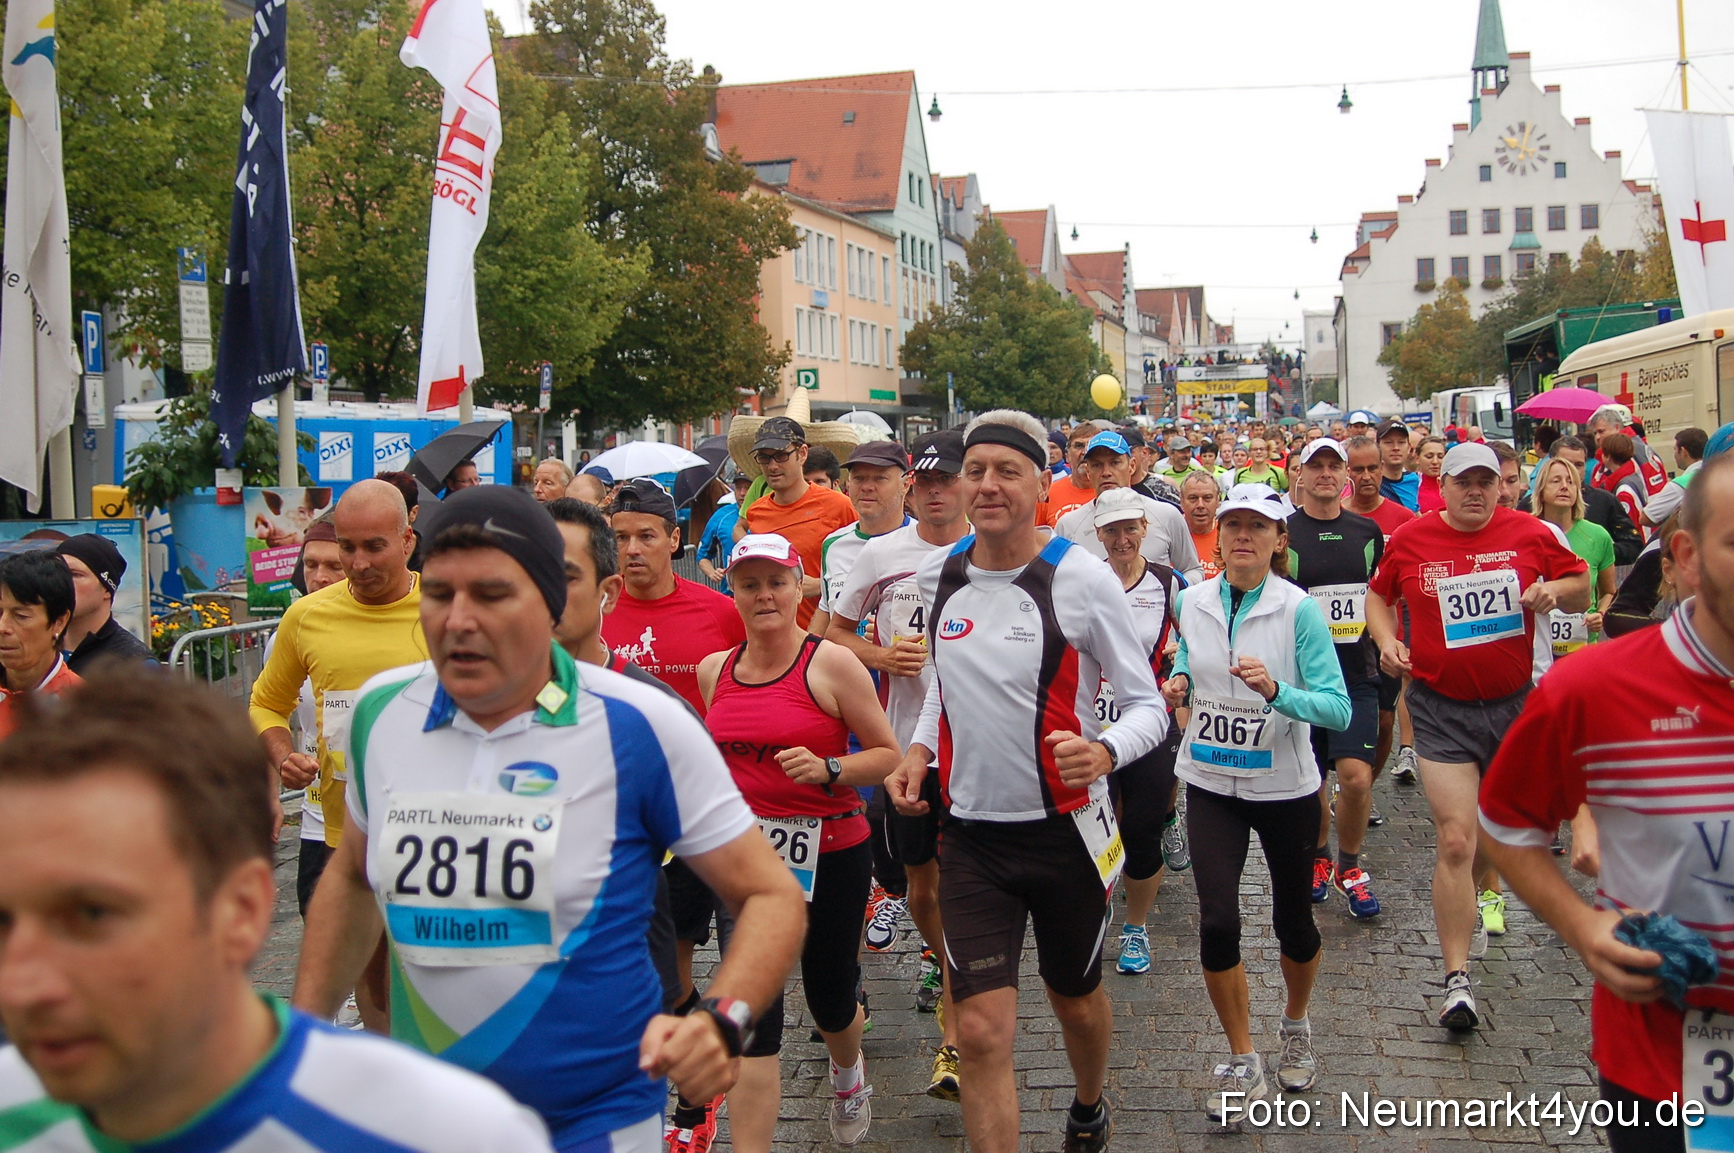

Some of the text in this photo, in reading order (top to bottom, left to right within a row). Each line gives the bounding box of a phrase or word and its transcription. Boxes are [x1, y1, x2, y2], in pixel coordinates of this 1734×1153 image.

[87, 320, 98, 365] P
[316, 348, 325, 376] P
[799, 371, 816, 388] D
[1638, 363, 1689, 389] Bayerisches
[1206, 383, 1236, 391] START
[1439, 577, 1504, 592] PARTL Neumarkt
[1330, 599, 1355, 620] 84
[1447, 586, 1511, 620] 3021
[909, 606, 925, 633] 4
[943, 620, 964, 632] tkn
[1470, 623, 1499, 634] Franz
[1551, 622, 1572, 640] 93
[1194, 698, 1260, 714] PARTL Neumarkt
[1198, 712, 1266, 746] 2067
[1651, 716, 1693, 732] PUMA
[1211, 751, 1247, 767] Margit
[387, 810, 524, 828] PARTL Neumarkt
[395, 834, 535, 901] 2816
[414, 915, 509, 941] Wilhelm
